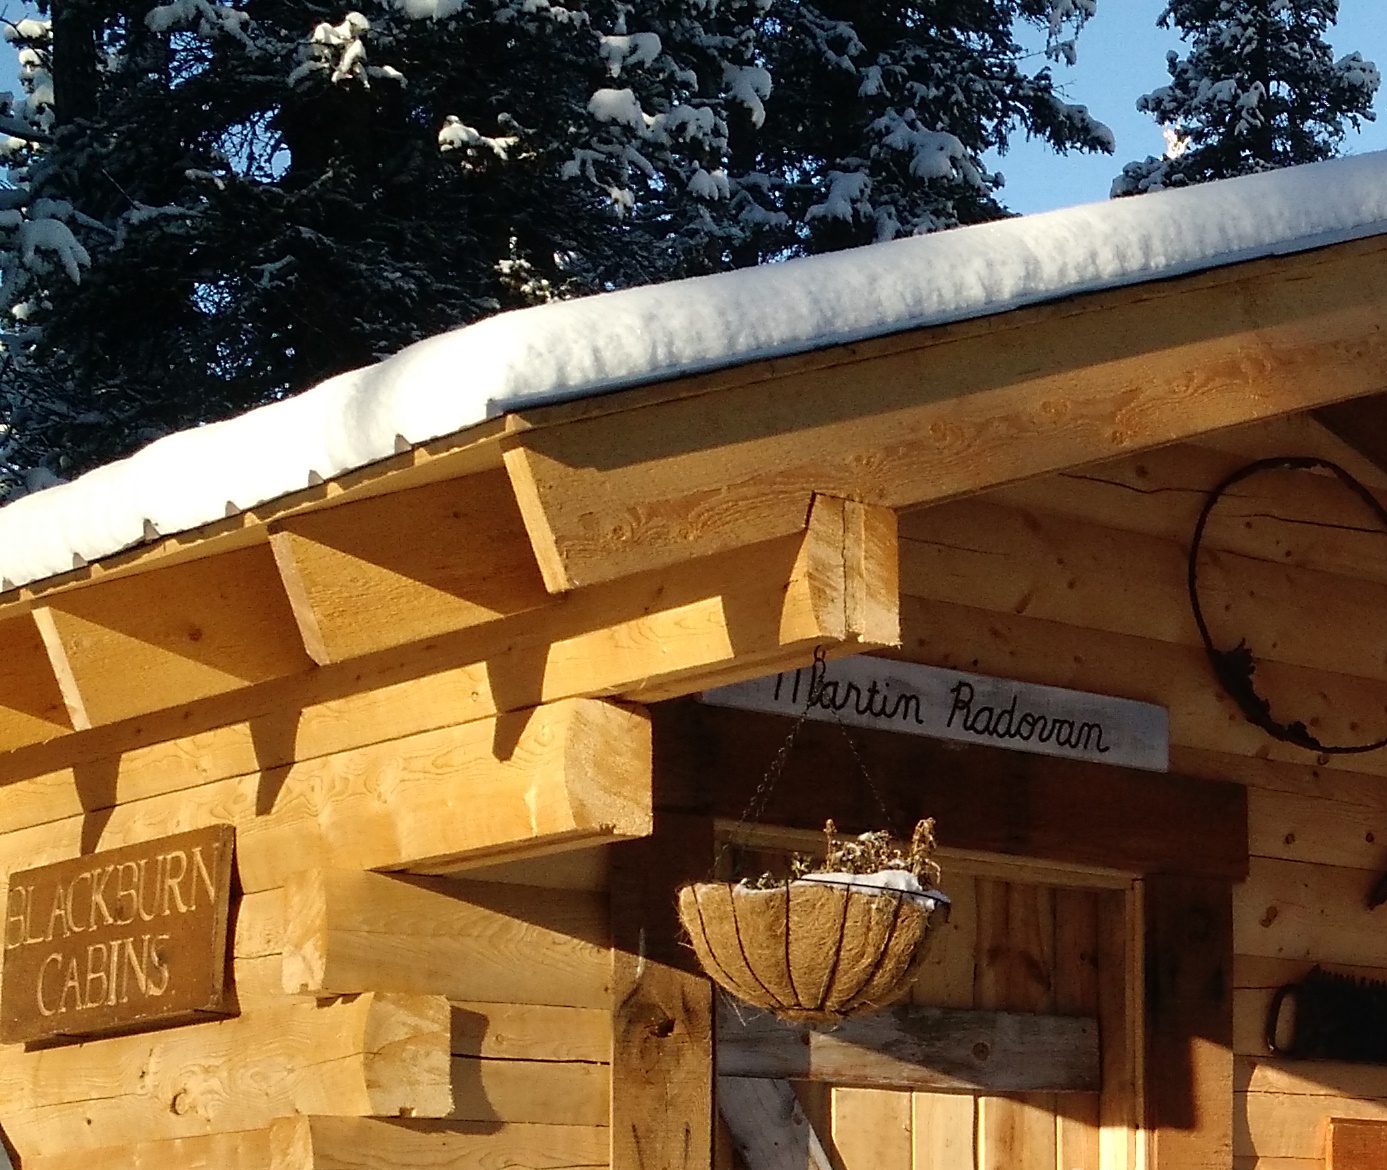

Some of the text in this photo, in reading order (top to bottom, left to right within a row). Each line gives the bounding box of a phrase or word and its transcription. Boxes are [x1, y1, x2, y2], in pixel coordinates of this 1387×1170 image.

[947, 681, 1110, 752] Radovan
[4, 842, 220, 950] BLACKBURN
[37, 934, 170, 1016] CABINS
